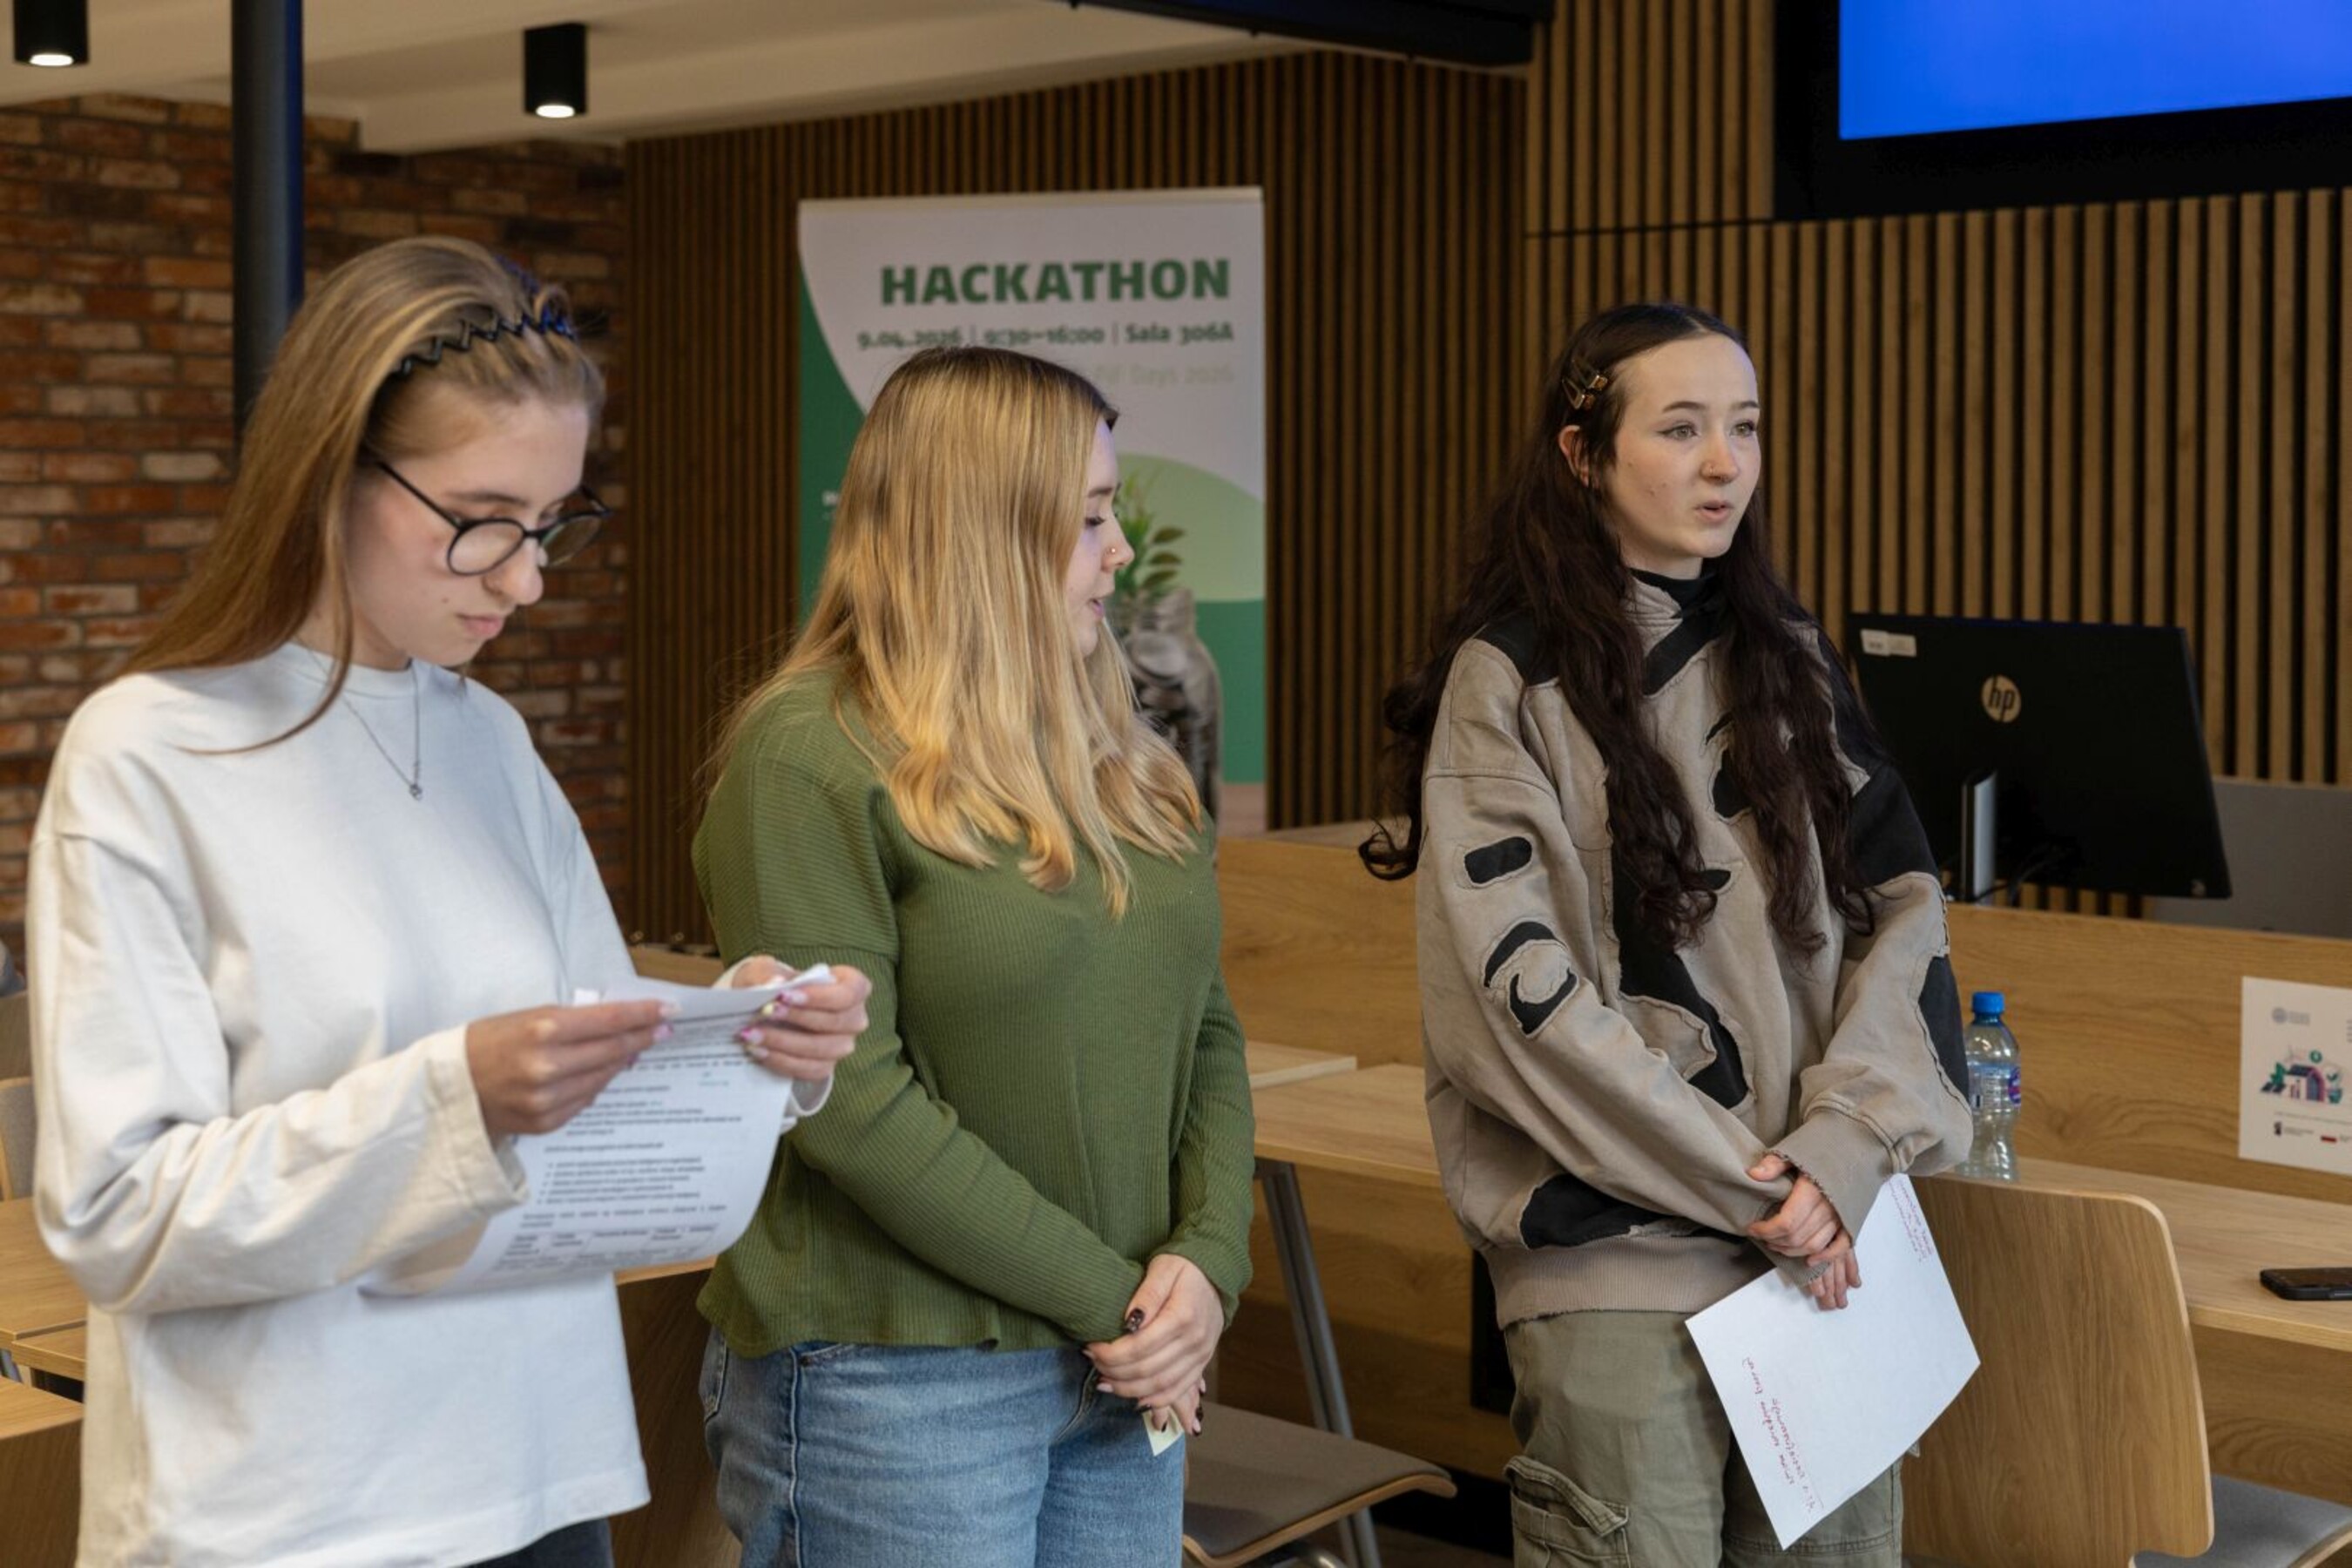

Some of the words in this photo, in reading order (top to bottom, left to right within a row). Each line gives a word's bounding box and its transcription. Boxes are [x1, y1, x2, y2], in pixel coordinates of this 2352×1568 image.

[881, 259, 1231, 305] HACKATHON
[1125, 323, 1171, 343] Sala
[1179, 321, 1234, 347] 306A
